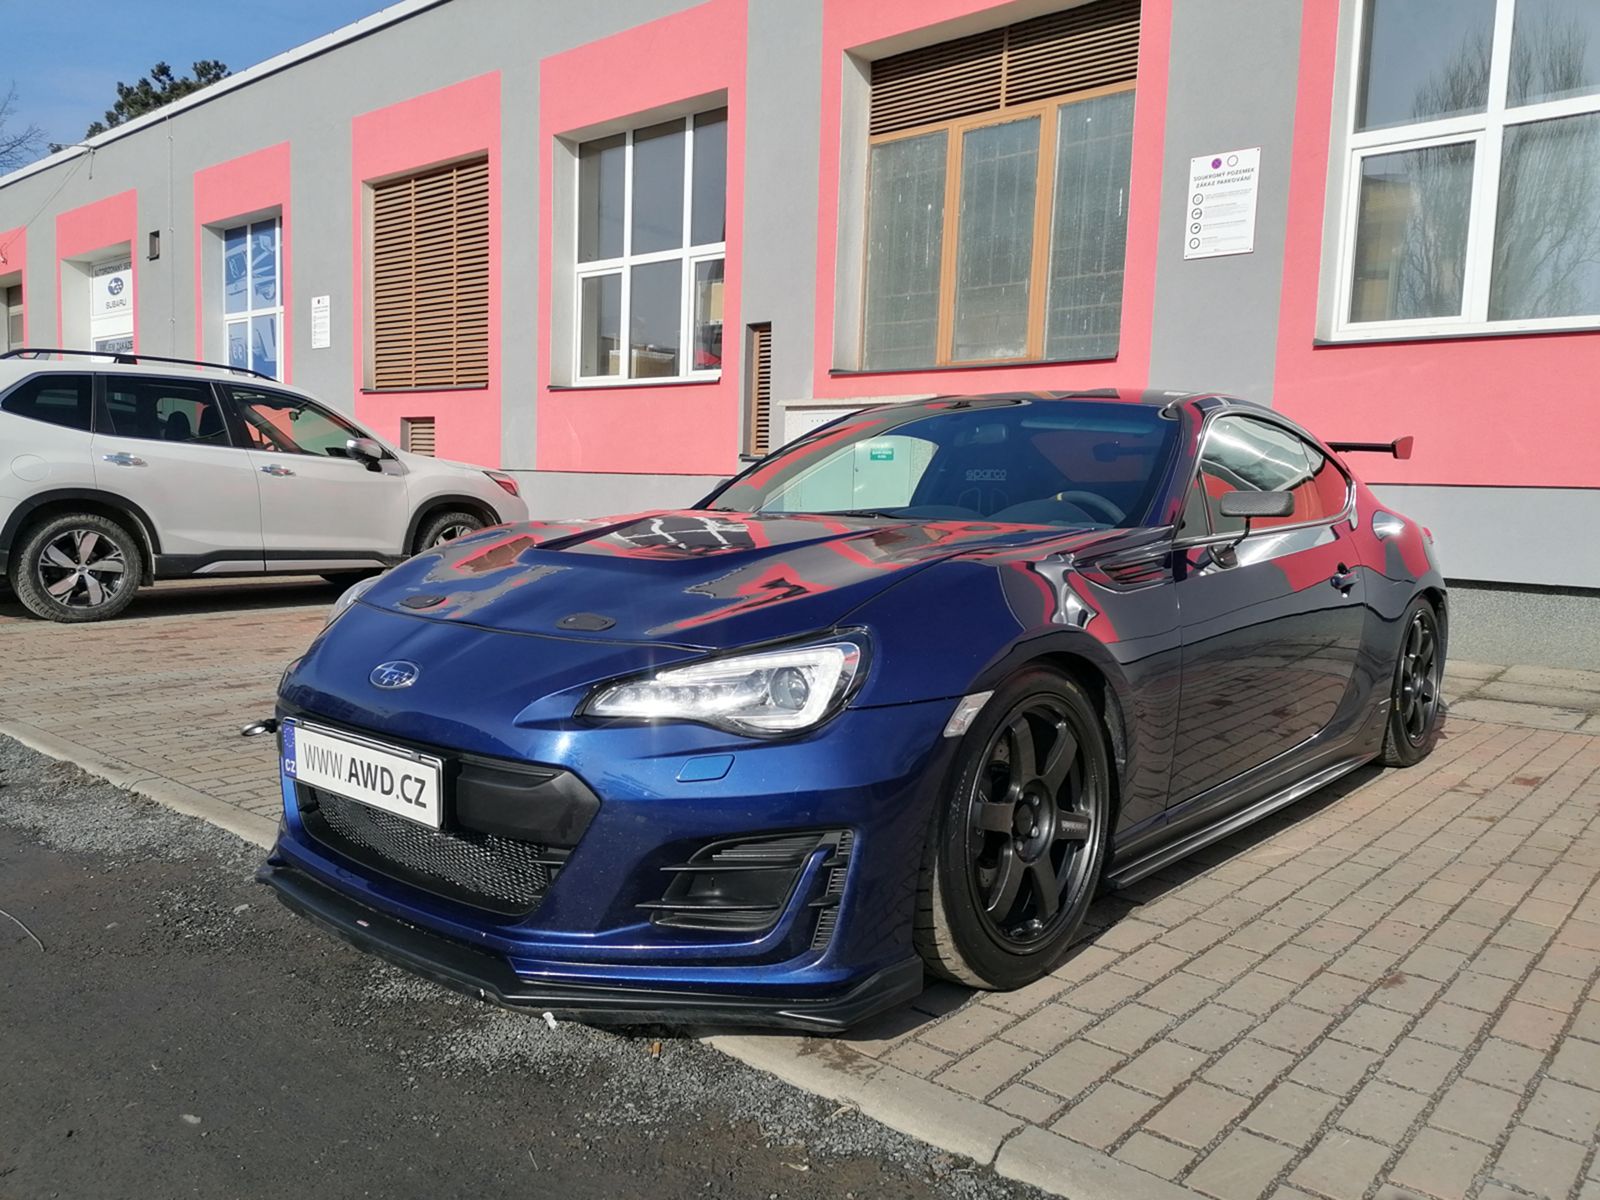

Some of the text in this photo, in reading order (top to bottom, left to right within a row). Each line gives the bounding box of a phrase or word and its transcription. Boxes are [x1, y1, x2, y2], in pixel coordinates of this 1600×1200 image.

[106, 298, 127, 310] SUBARU
[966, 469, 1007, 481] sparco
[285, 758, 296, 773] CZ
[304, 743, 427, 809] WWW.AWD.CZ
